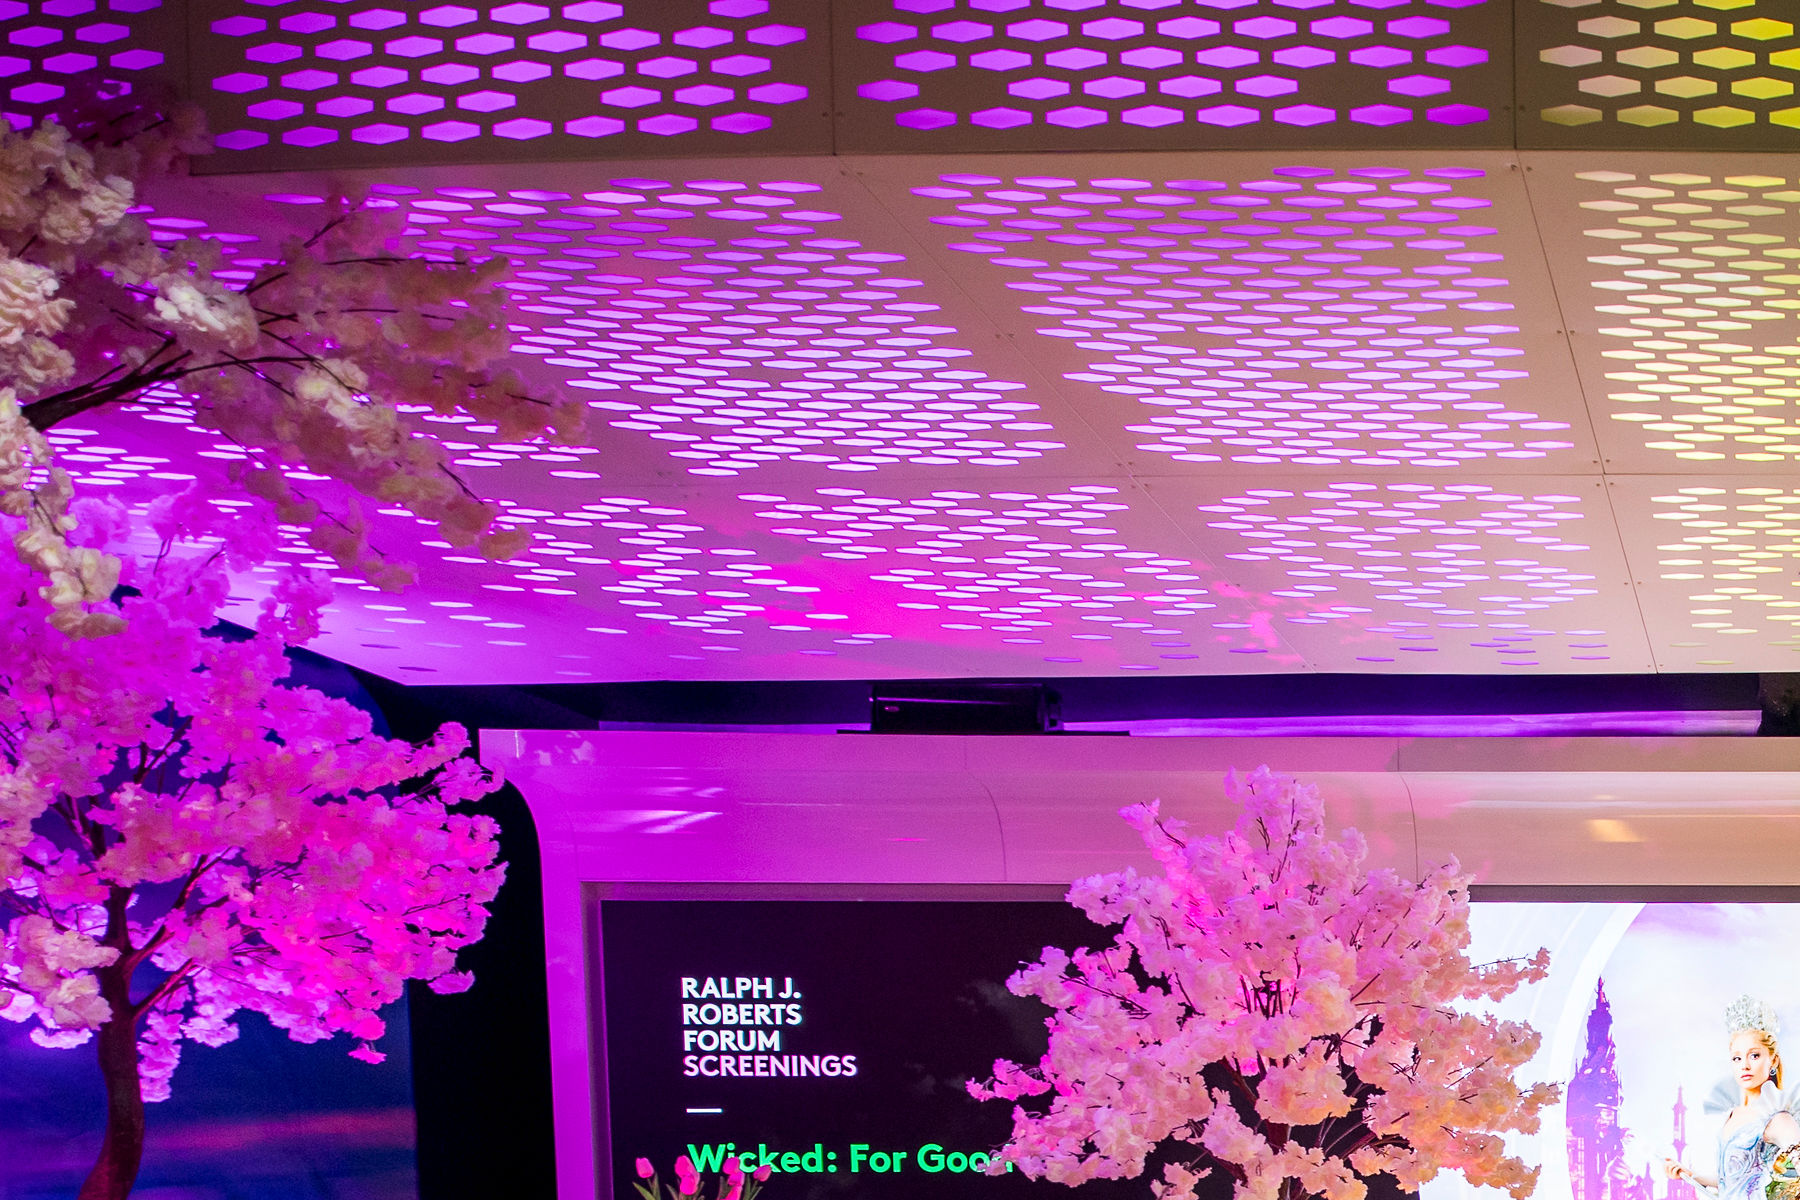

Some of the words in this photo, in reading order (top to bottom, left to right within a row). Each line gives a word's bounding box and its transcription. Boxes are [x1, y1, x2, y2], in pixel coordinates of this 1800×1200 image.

[681, 976, 774, 999] RALPH
[778, 976, 802, 999] J.
[682, 1003, 803, 1025] ROBERTS
[683, 1029, 782, 1052] FORUM
[683, 1054, 858, 1077] SCREENINGS
[850, 1143, 907, 1173] For
[917, 1143, 1013, 1173] Goo
